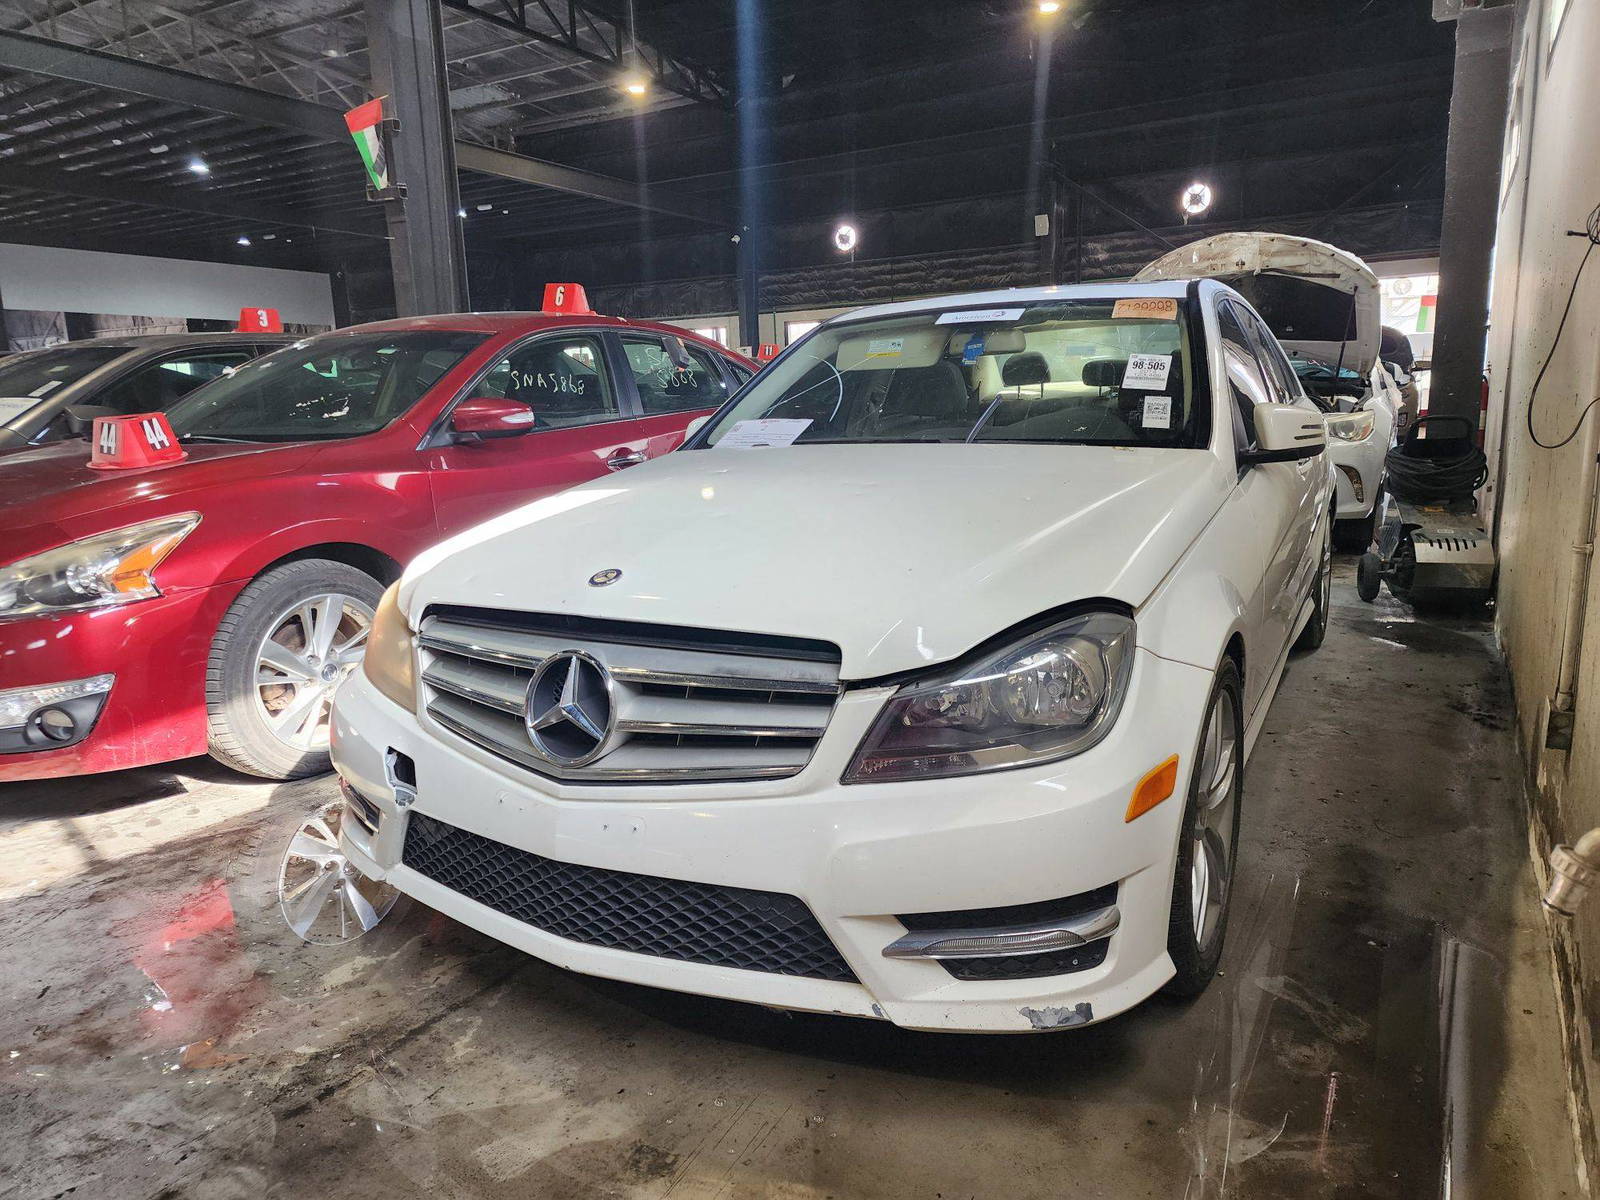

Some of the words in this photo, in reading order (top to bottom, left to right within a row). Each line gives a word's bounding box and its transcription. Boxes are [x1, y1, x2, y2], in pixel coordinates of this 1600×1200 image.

[555, 286, 564, 306] 6
[257, 309, 268, 328] 3
[765, 345, 773, 356] 11
[101, 422, 116, 454] 44
[141, 418, 170, 450] 44
